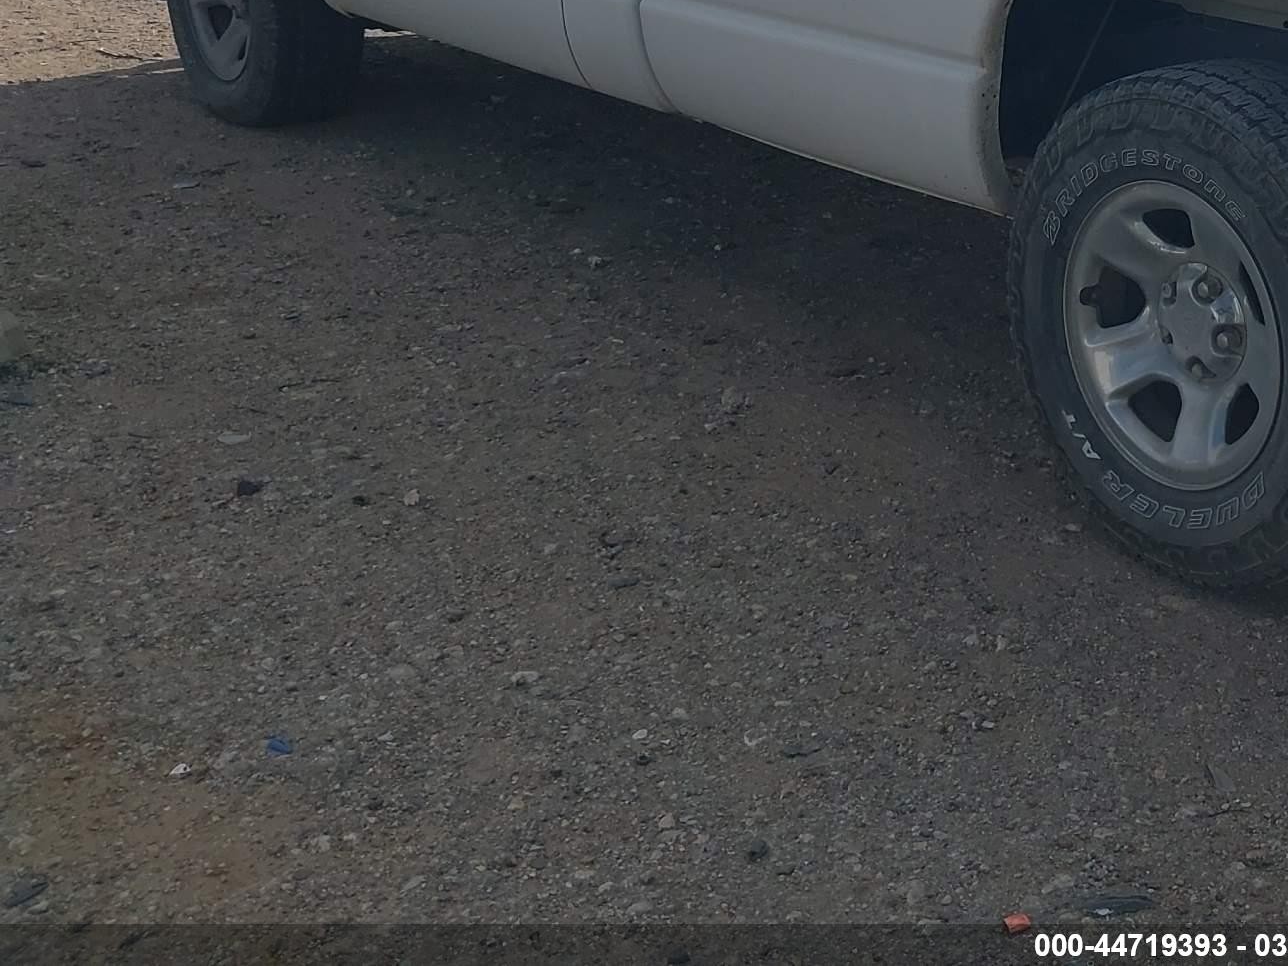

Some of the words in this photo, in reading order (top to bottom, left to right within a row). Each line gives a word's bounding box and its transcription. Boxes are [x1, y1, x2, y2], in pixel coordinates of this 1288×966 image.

[1043, 148, 1247, 246] BRIDGESTONE
[1062, 409, 1101, 460] A/T
[1102, 470, 1265, 530] DUELER
